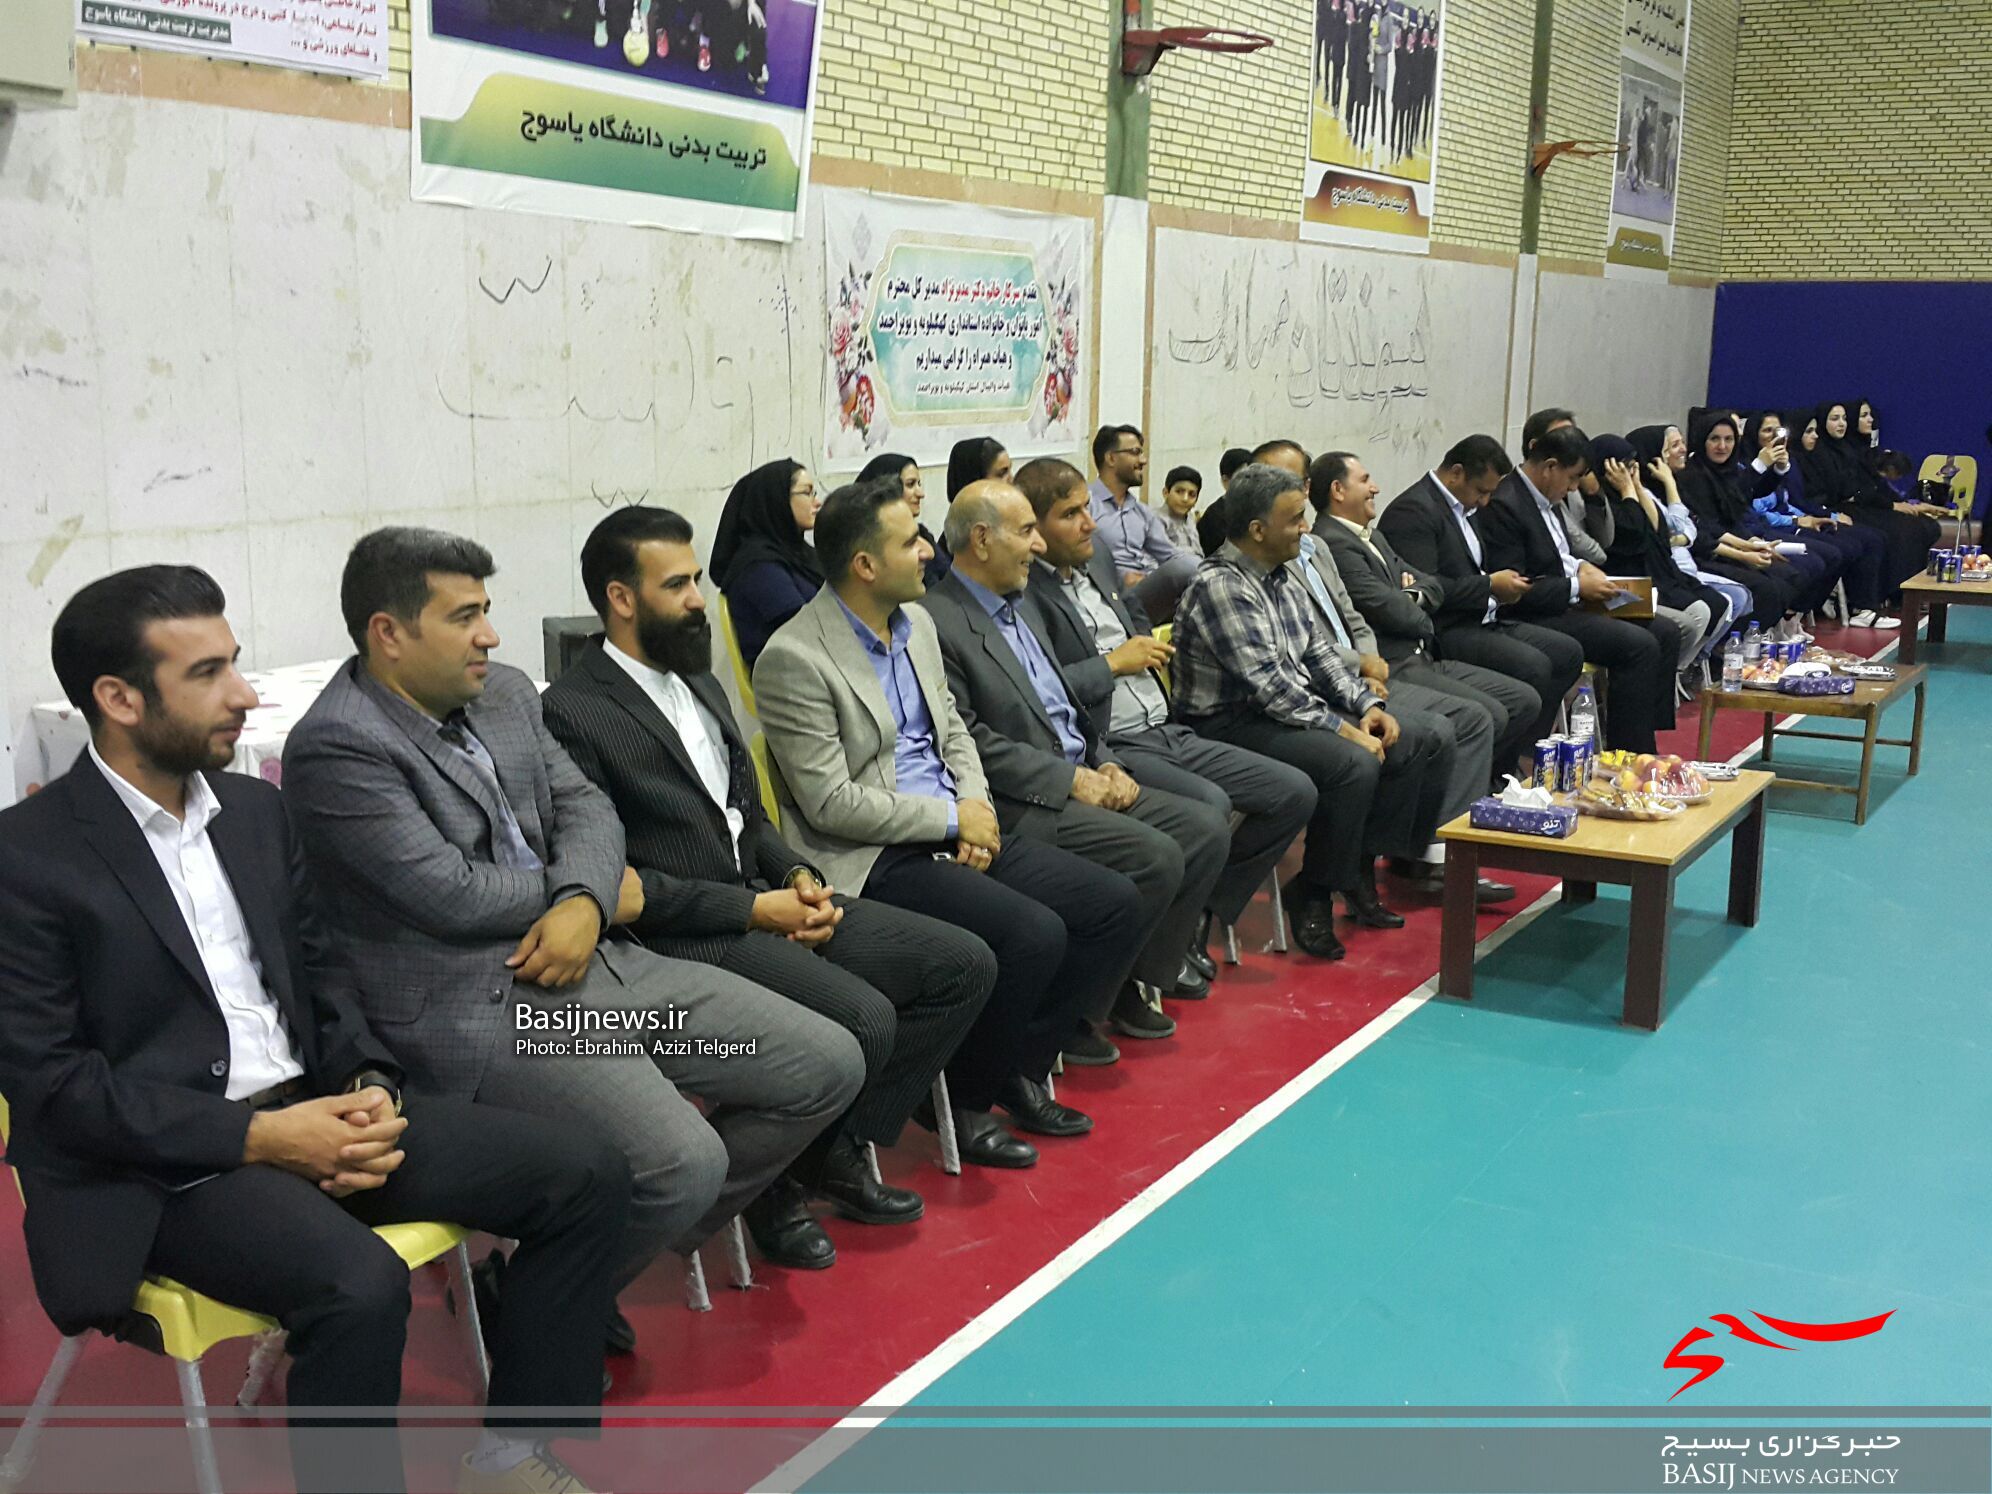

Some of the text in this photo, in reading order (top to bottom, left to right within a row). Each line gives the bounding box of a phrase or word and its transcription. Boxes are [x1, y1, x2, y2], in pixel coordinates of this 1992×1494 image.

[84, 5, 112, 25] یاسوج
[113, 8, 147, 28] دانشگاه
[520, 109, 767, 170] تربیت بدنی دانشگاه یاسوج
[887, 277, 910, 300] محترم
[971, 279, 985, 303] دکتر
[919, 311, 947, 337] کهگیلویه
[948, 313, 981, 338] استانداری
[943, 346, 965, 371] گرامی
